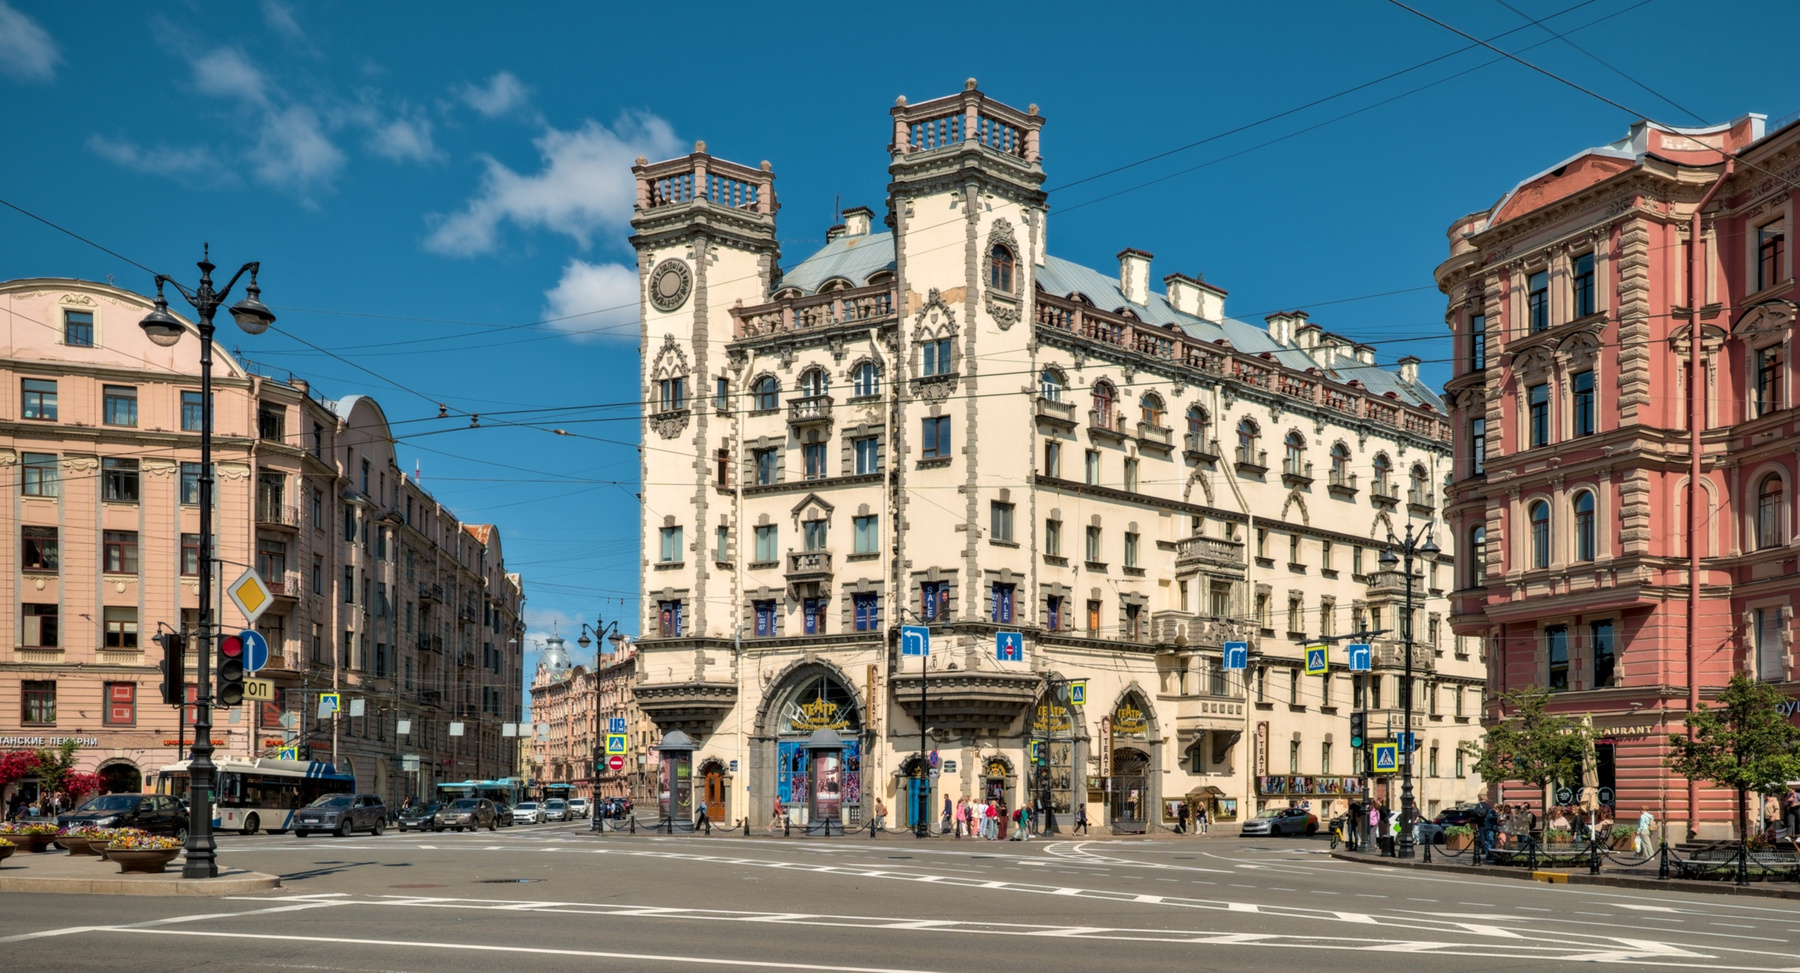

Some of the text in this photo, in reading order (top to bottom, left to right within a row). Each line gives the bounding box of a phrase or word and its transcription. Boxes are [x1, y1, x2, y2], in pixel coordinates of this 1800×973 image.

[243, 681, 267, 697] ТОП
[802, 697, 837, 716] ТЕАТР
[1117, 703, 1141, 719] ТЕАТР
[1600, 725, 1653, 736] AURANT
